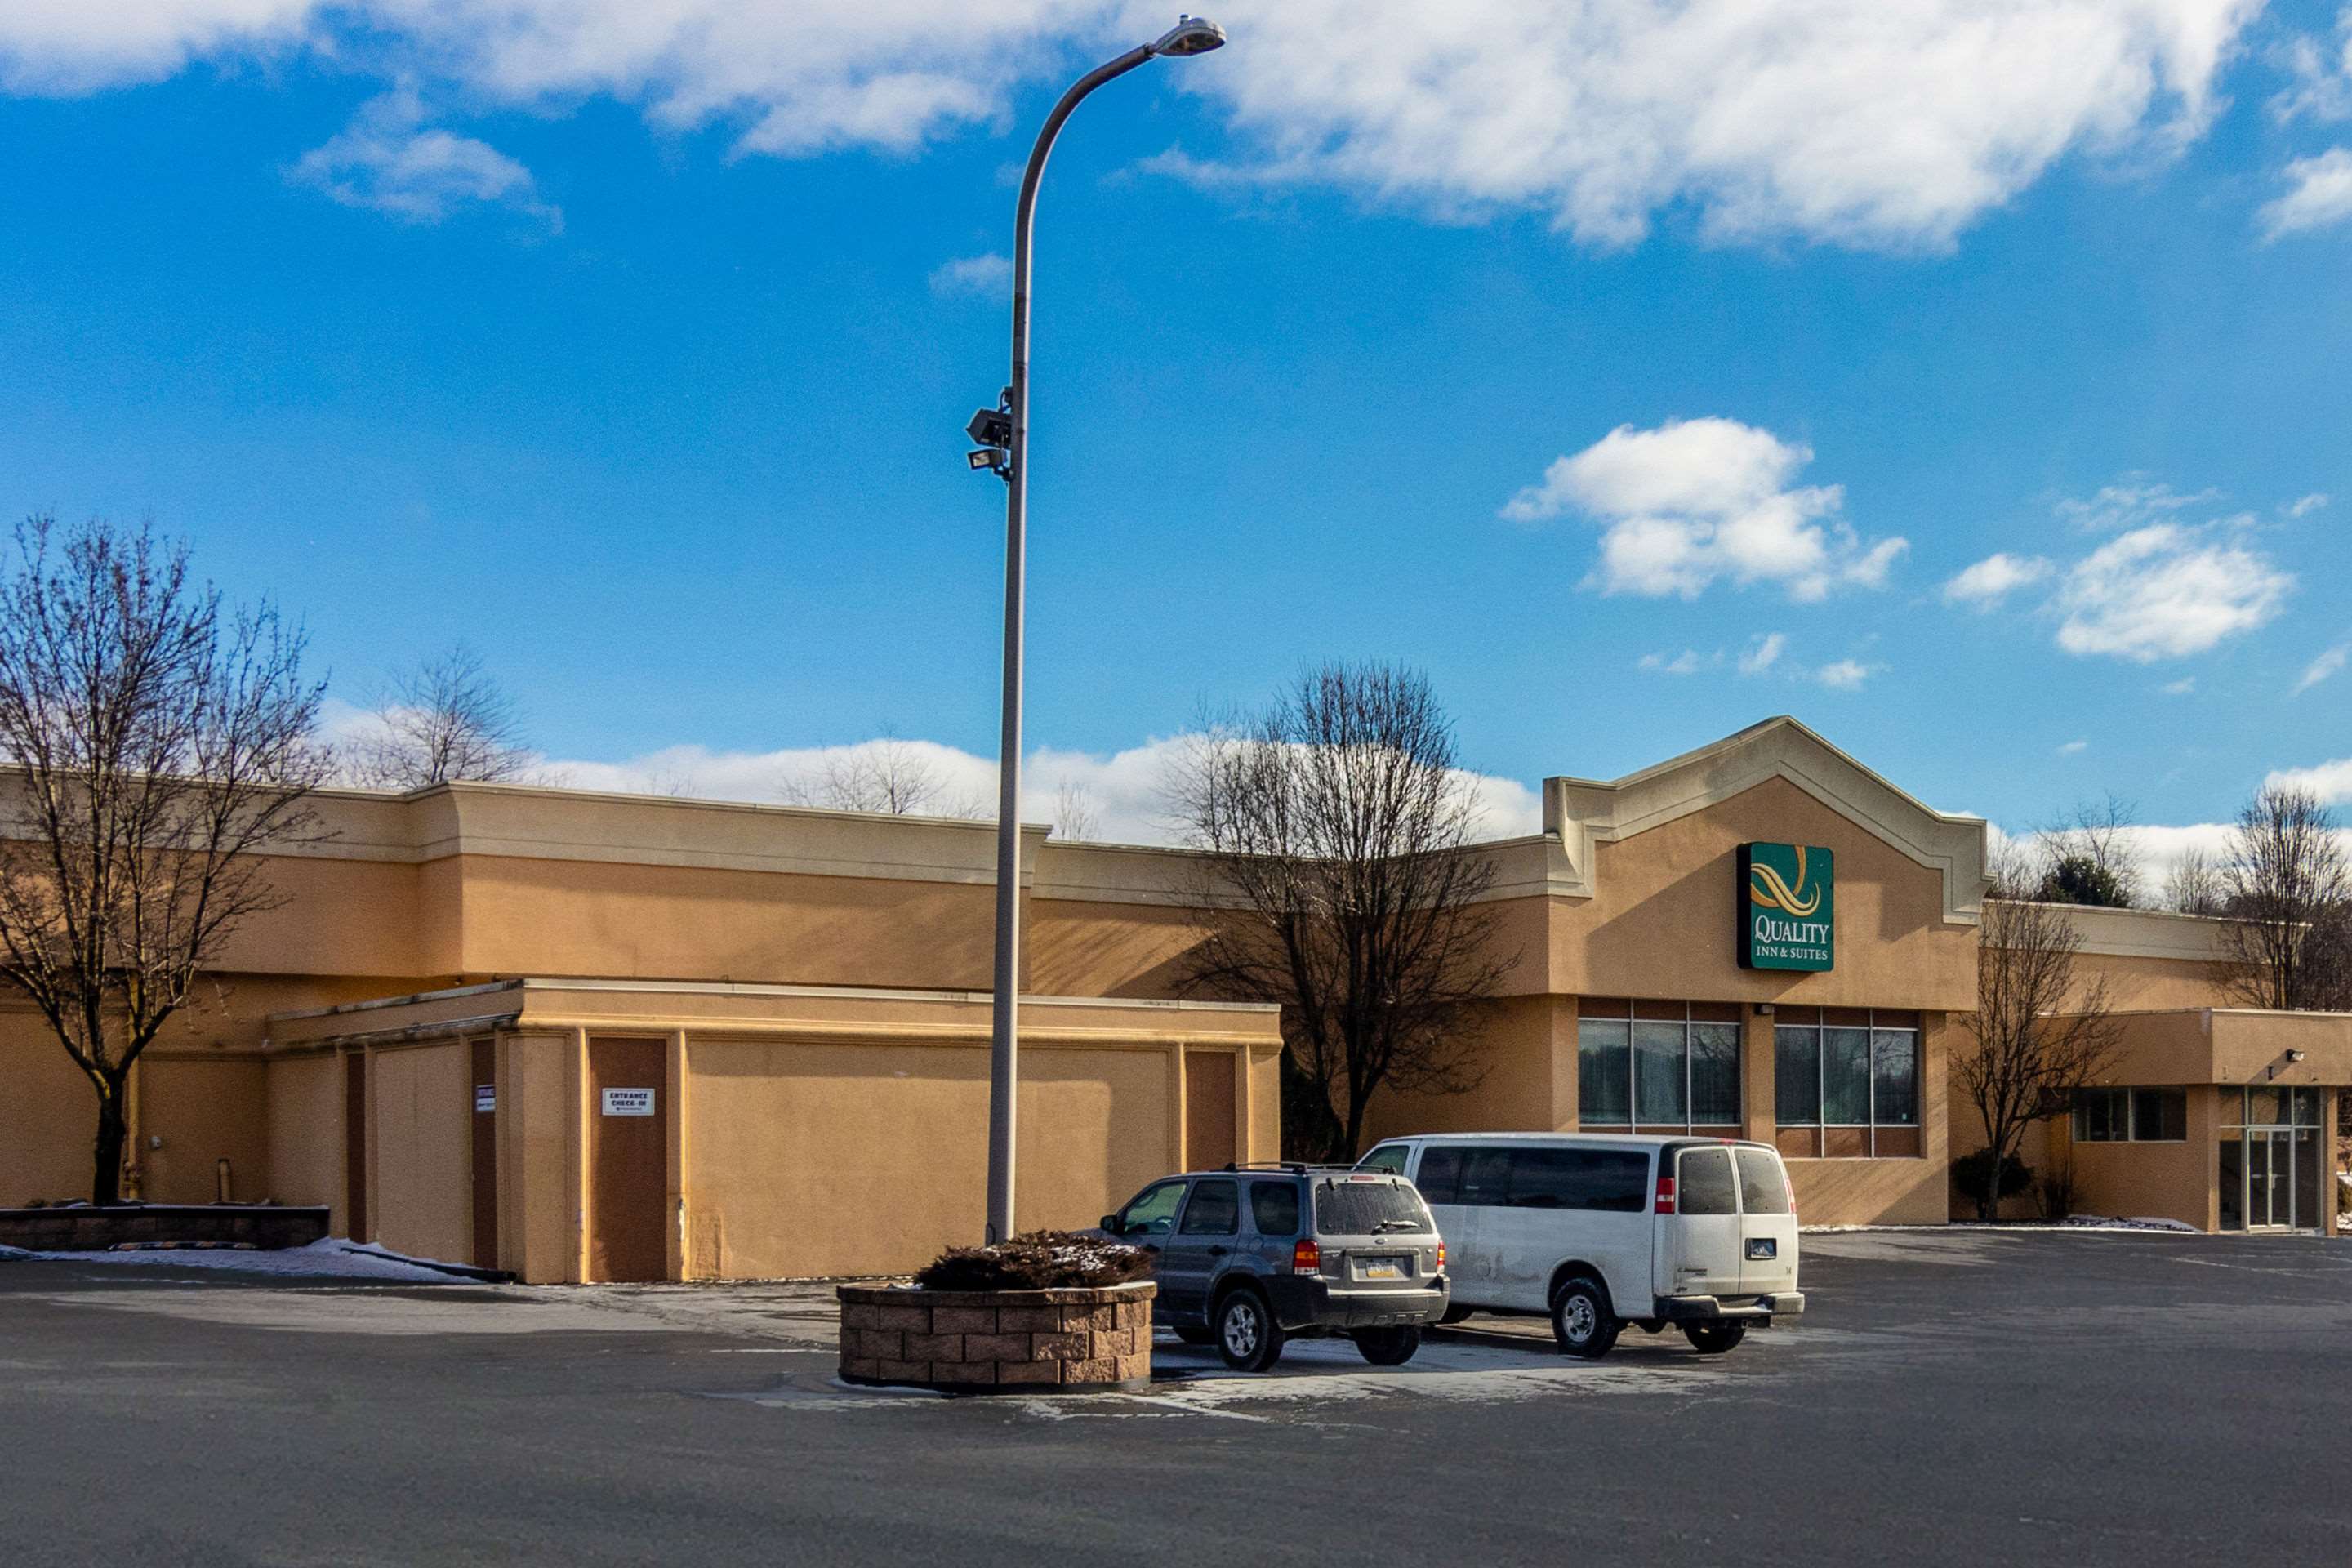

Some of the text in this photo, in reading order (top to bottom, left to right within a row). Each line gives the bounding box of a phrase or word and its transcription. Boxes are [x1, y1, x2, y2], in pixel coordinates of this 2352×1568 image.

[1755, 915, 1829, 944] QUALITY
[1757, 946, 1829, 960] INN & SUITES
